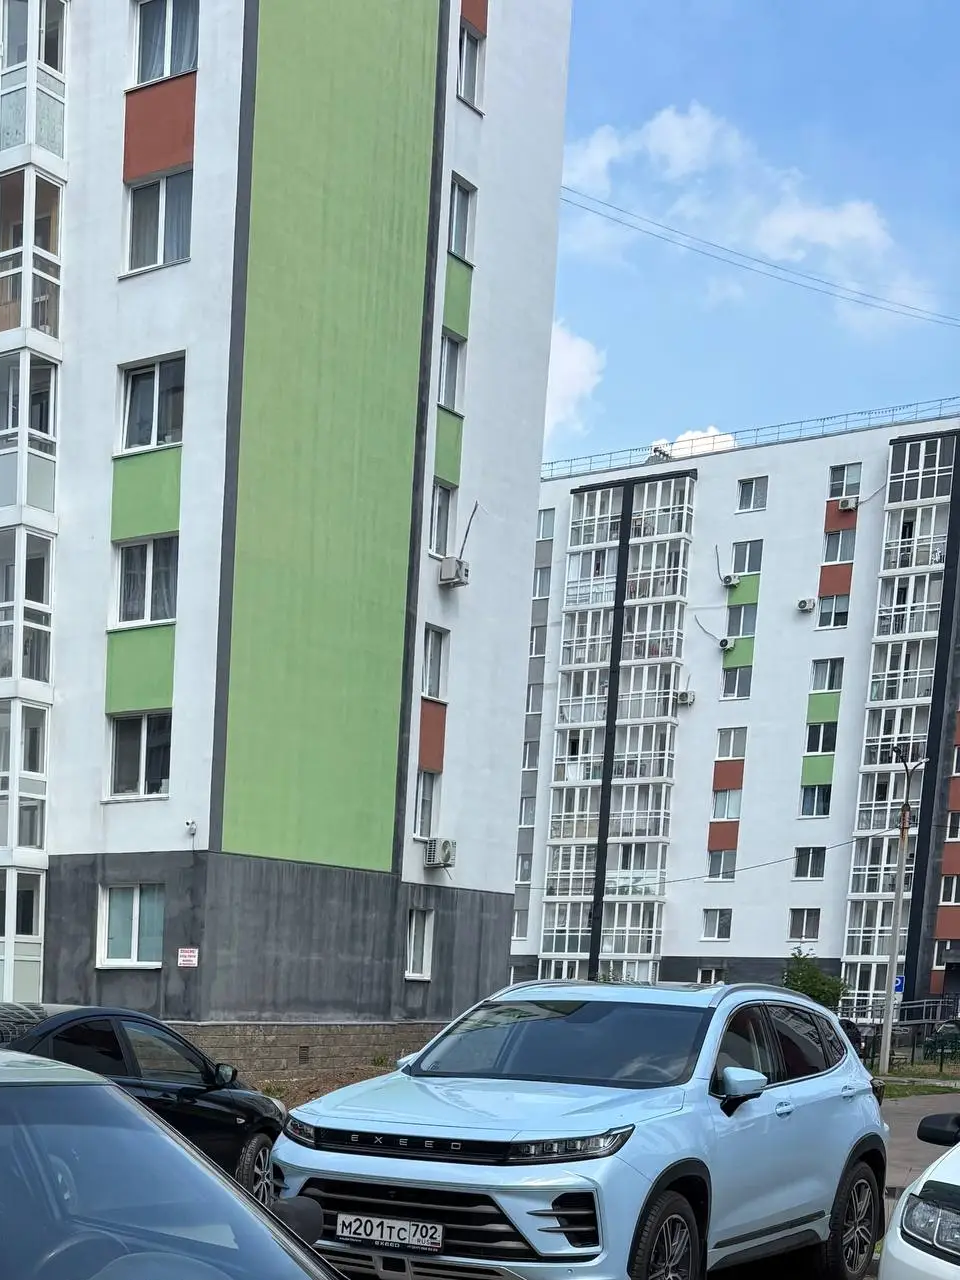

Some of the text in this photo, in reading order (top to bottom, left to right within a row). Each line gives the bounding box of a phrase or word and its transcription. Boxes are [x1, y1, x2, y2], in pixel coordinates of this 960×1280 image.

[351, 1134, 461, 1150] EXEED
[341, 1218, 438, 1241] М201ТС 702
